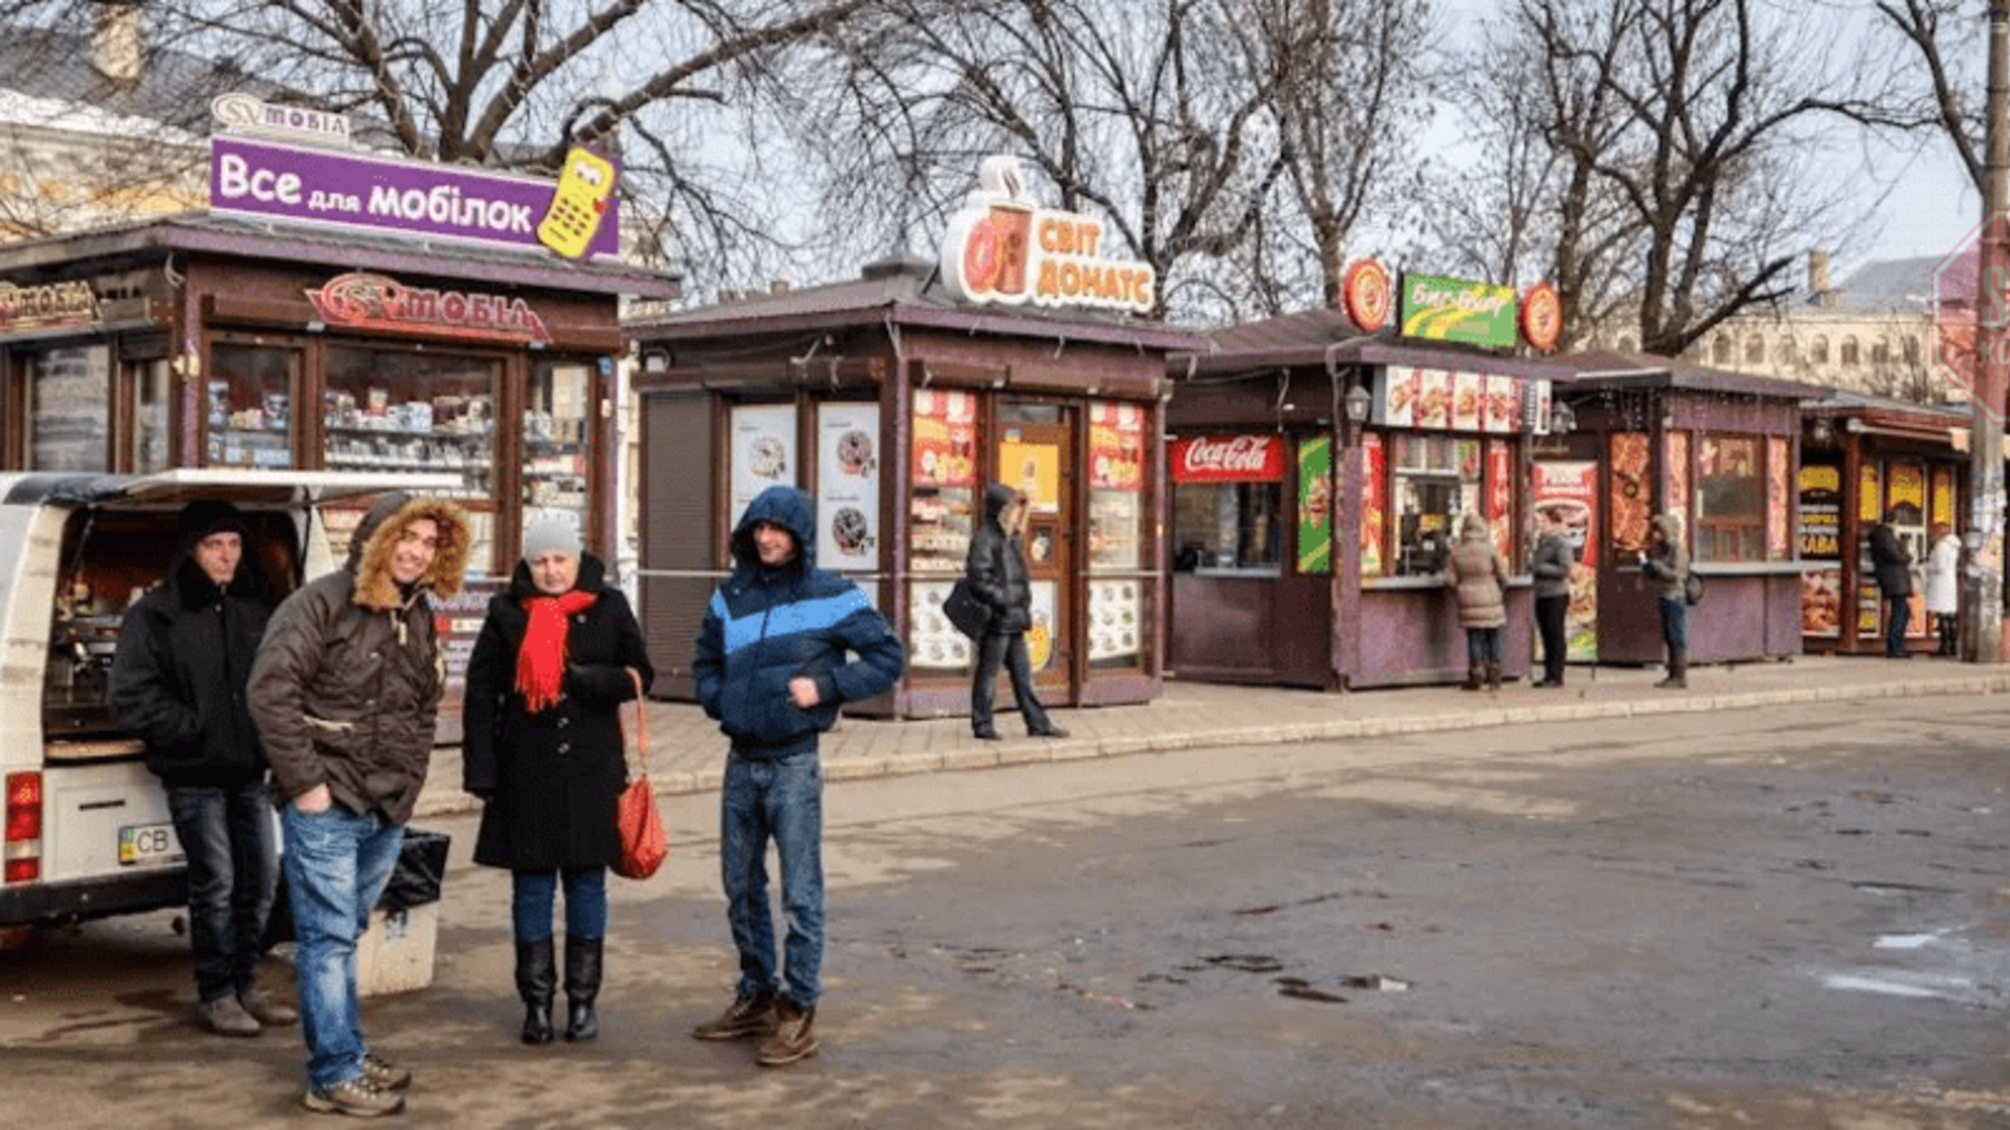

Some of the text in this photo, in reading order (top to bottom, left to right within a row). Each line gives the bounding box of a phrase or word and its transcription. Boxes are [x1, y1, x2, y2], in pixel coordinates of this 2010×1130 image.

[220, 153, 532, 233] Все для мобілок
[1039, 218, 1100, 256] СВІТ
[1036, 260, 1150, 304] ДОНАТС
[1184, 435, 1269, 472] Coca-Cola
